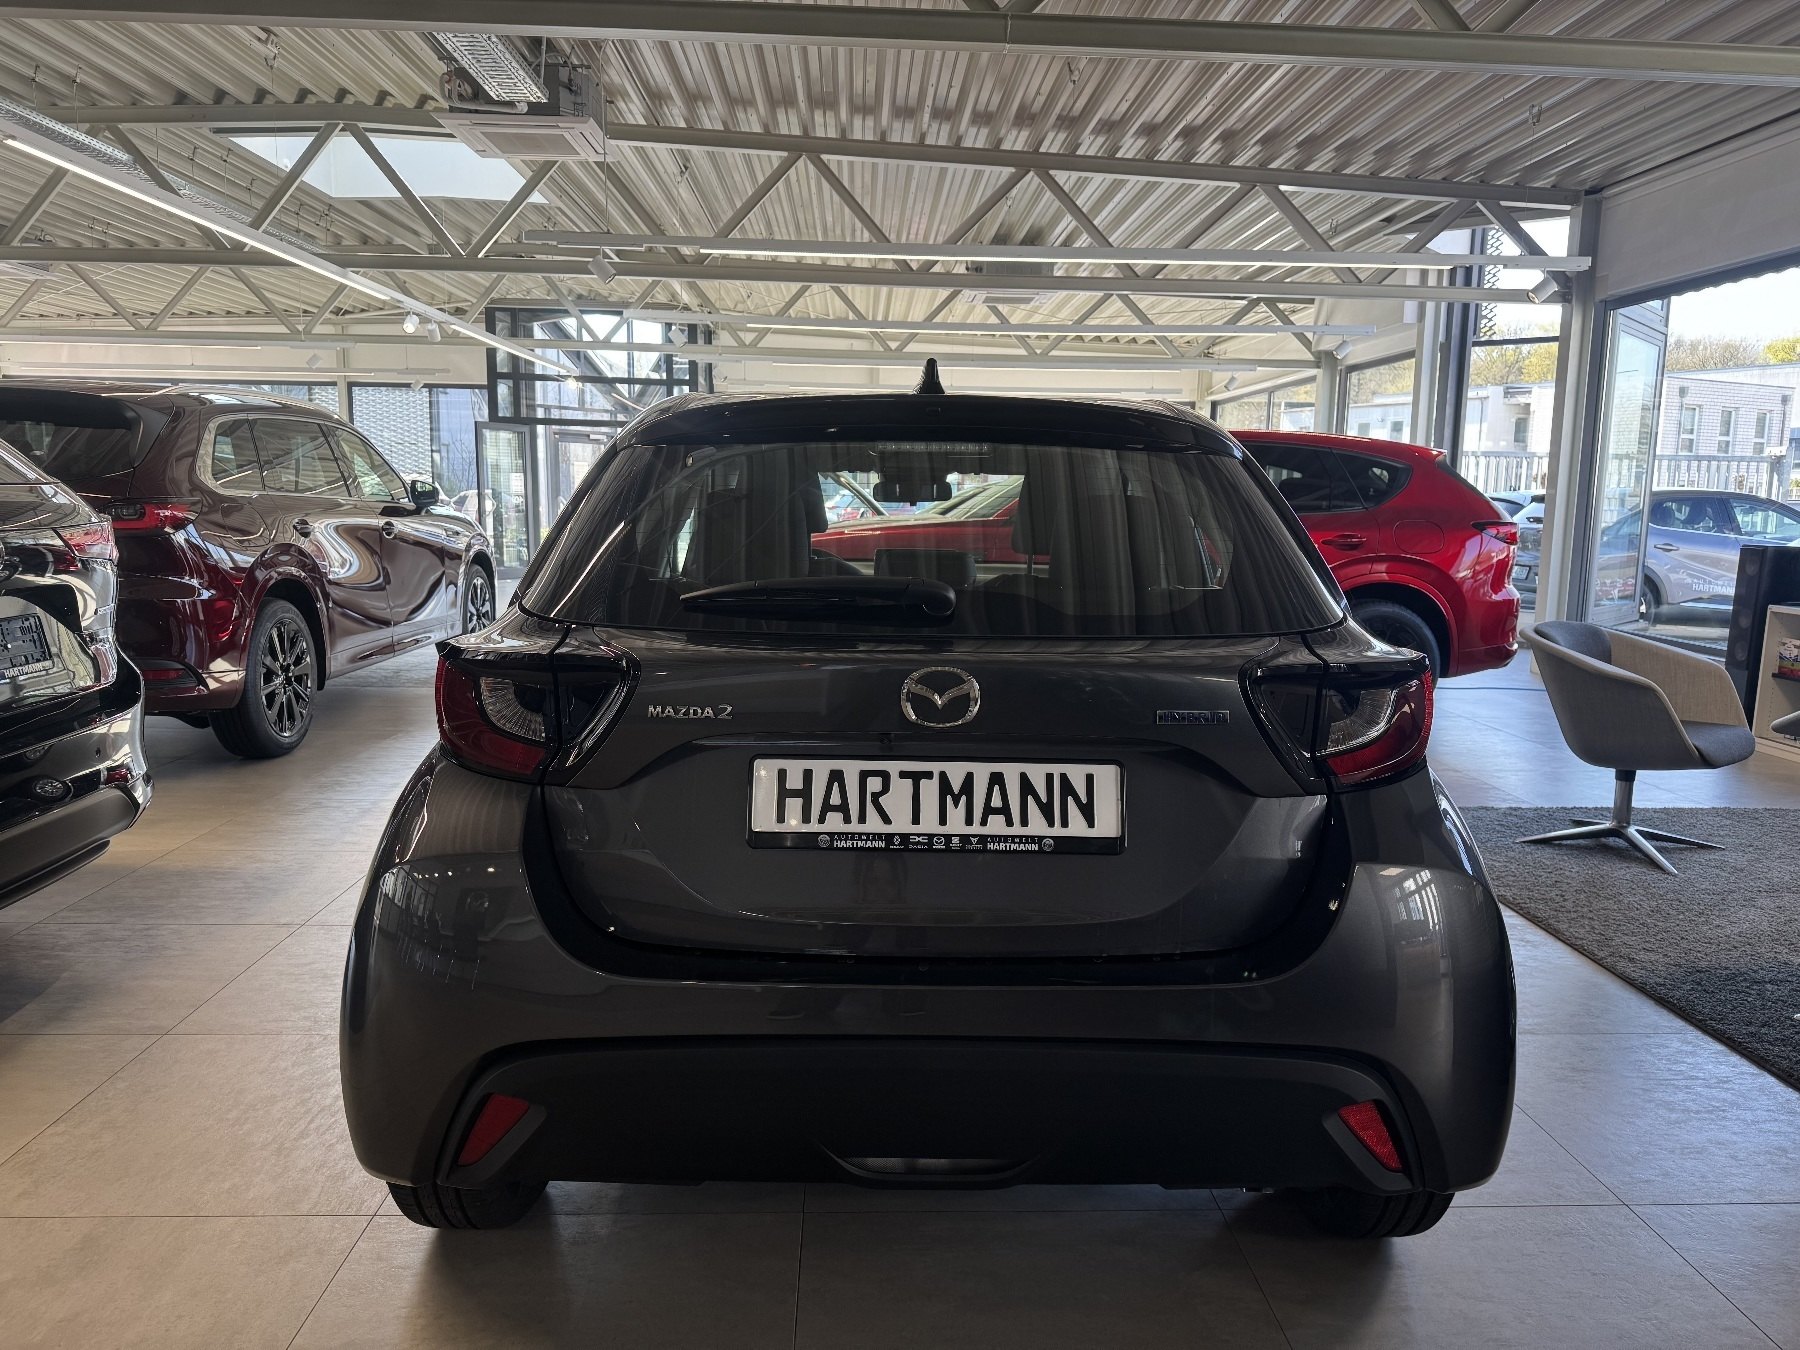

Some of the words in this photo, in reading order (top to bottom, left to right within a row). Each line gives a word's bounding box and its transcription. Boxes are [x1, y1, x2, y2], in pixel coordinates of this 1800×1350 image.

[4, 663, 42, 678] HARTMANN
[775, 768, 1096, 829] HARTMANN
[833, 840, 885, 848] HARTMANN
[987, 843, 1039, 851] HARTMANN
